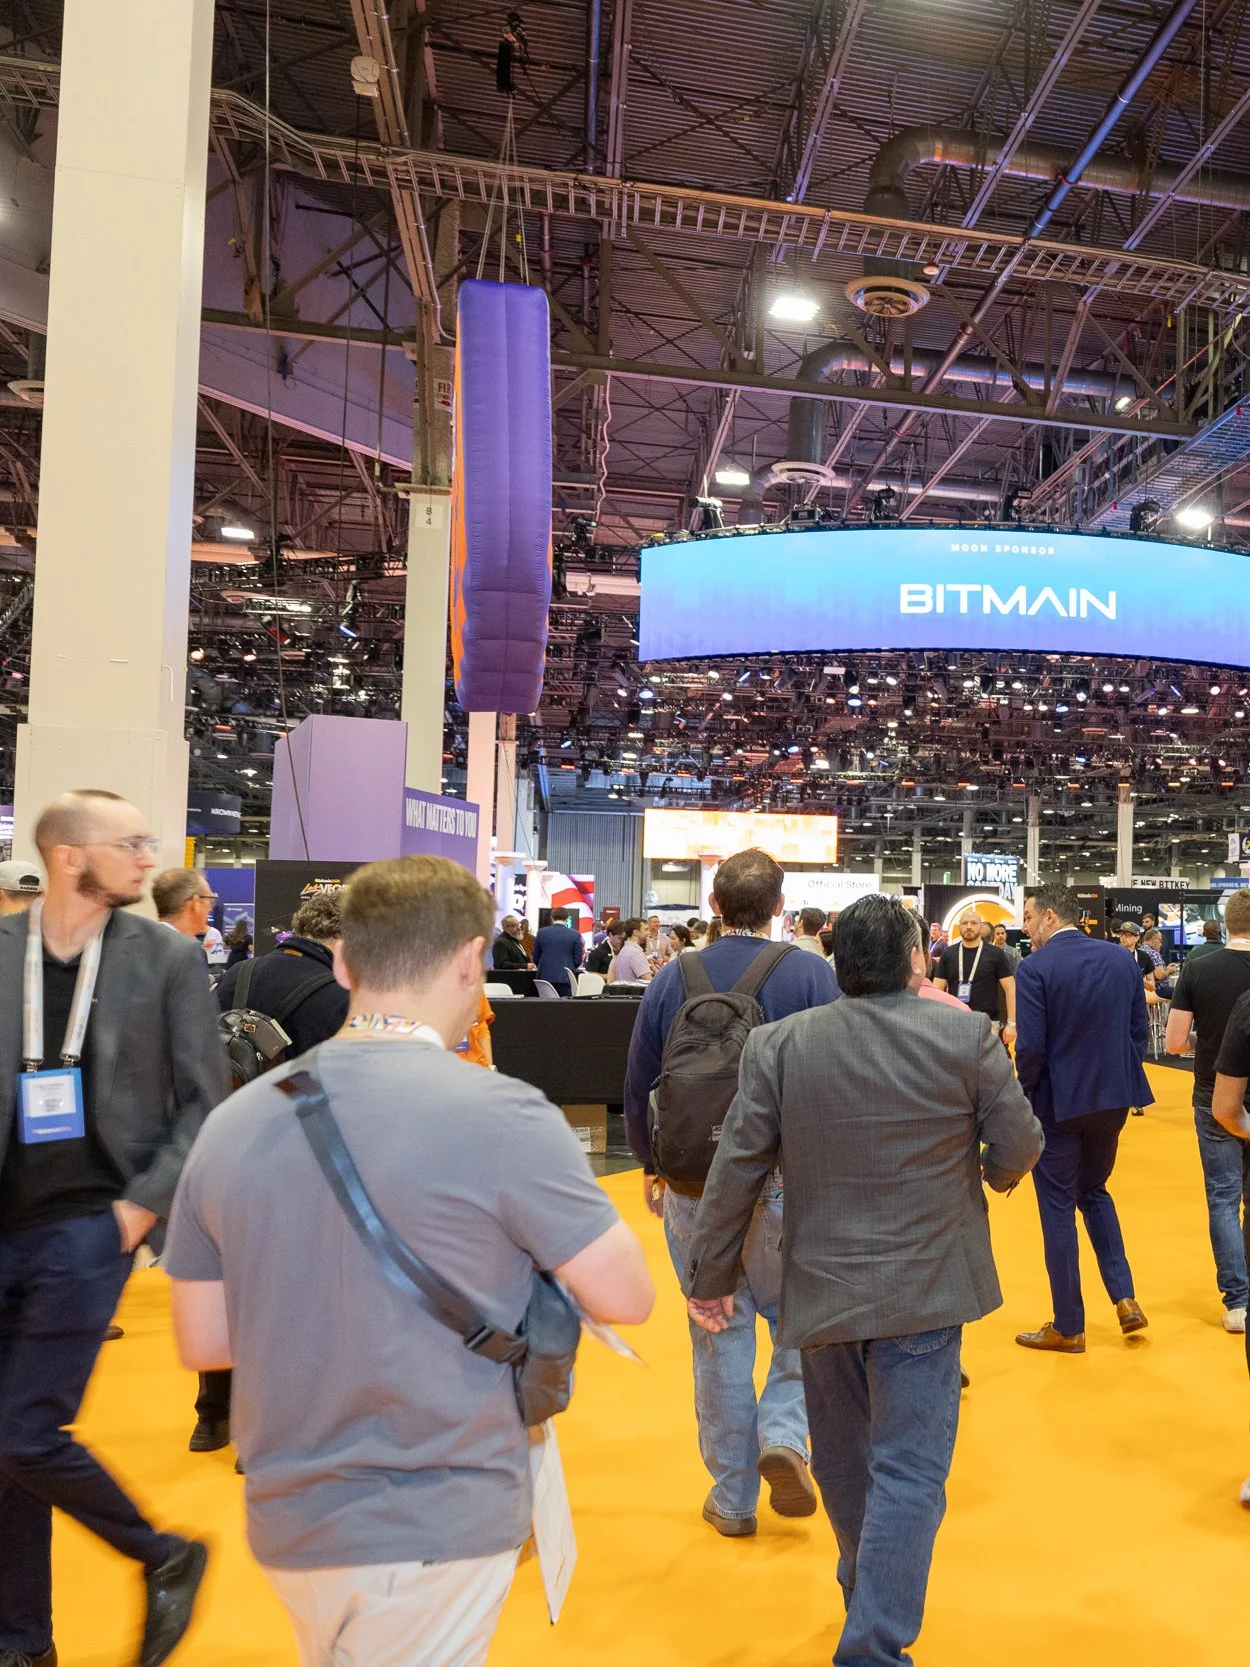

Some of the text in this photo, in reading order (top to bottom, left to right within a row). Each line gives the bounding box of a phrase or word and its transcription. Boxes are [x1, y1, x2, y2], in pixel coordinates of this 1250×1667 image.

[426, 506, 433, 516] B
[951, 543, 1055, 555] MOON SPONSOR
[900, 583, 1117, 620] BITMAIN
[406, 797, 478, 838] WHAT MATTERS TO YOU
[967, 862, 1017, 882] NO MORE
[808, 879, 872, 889] Official Store
[1159, 880, 1190, 889] BITKEY
